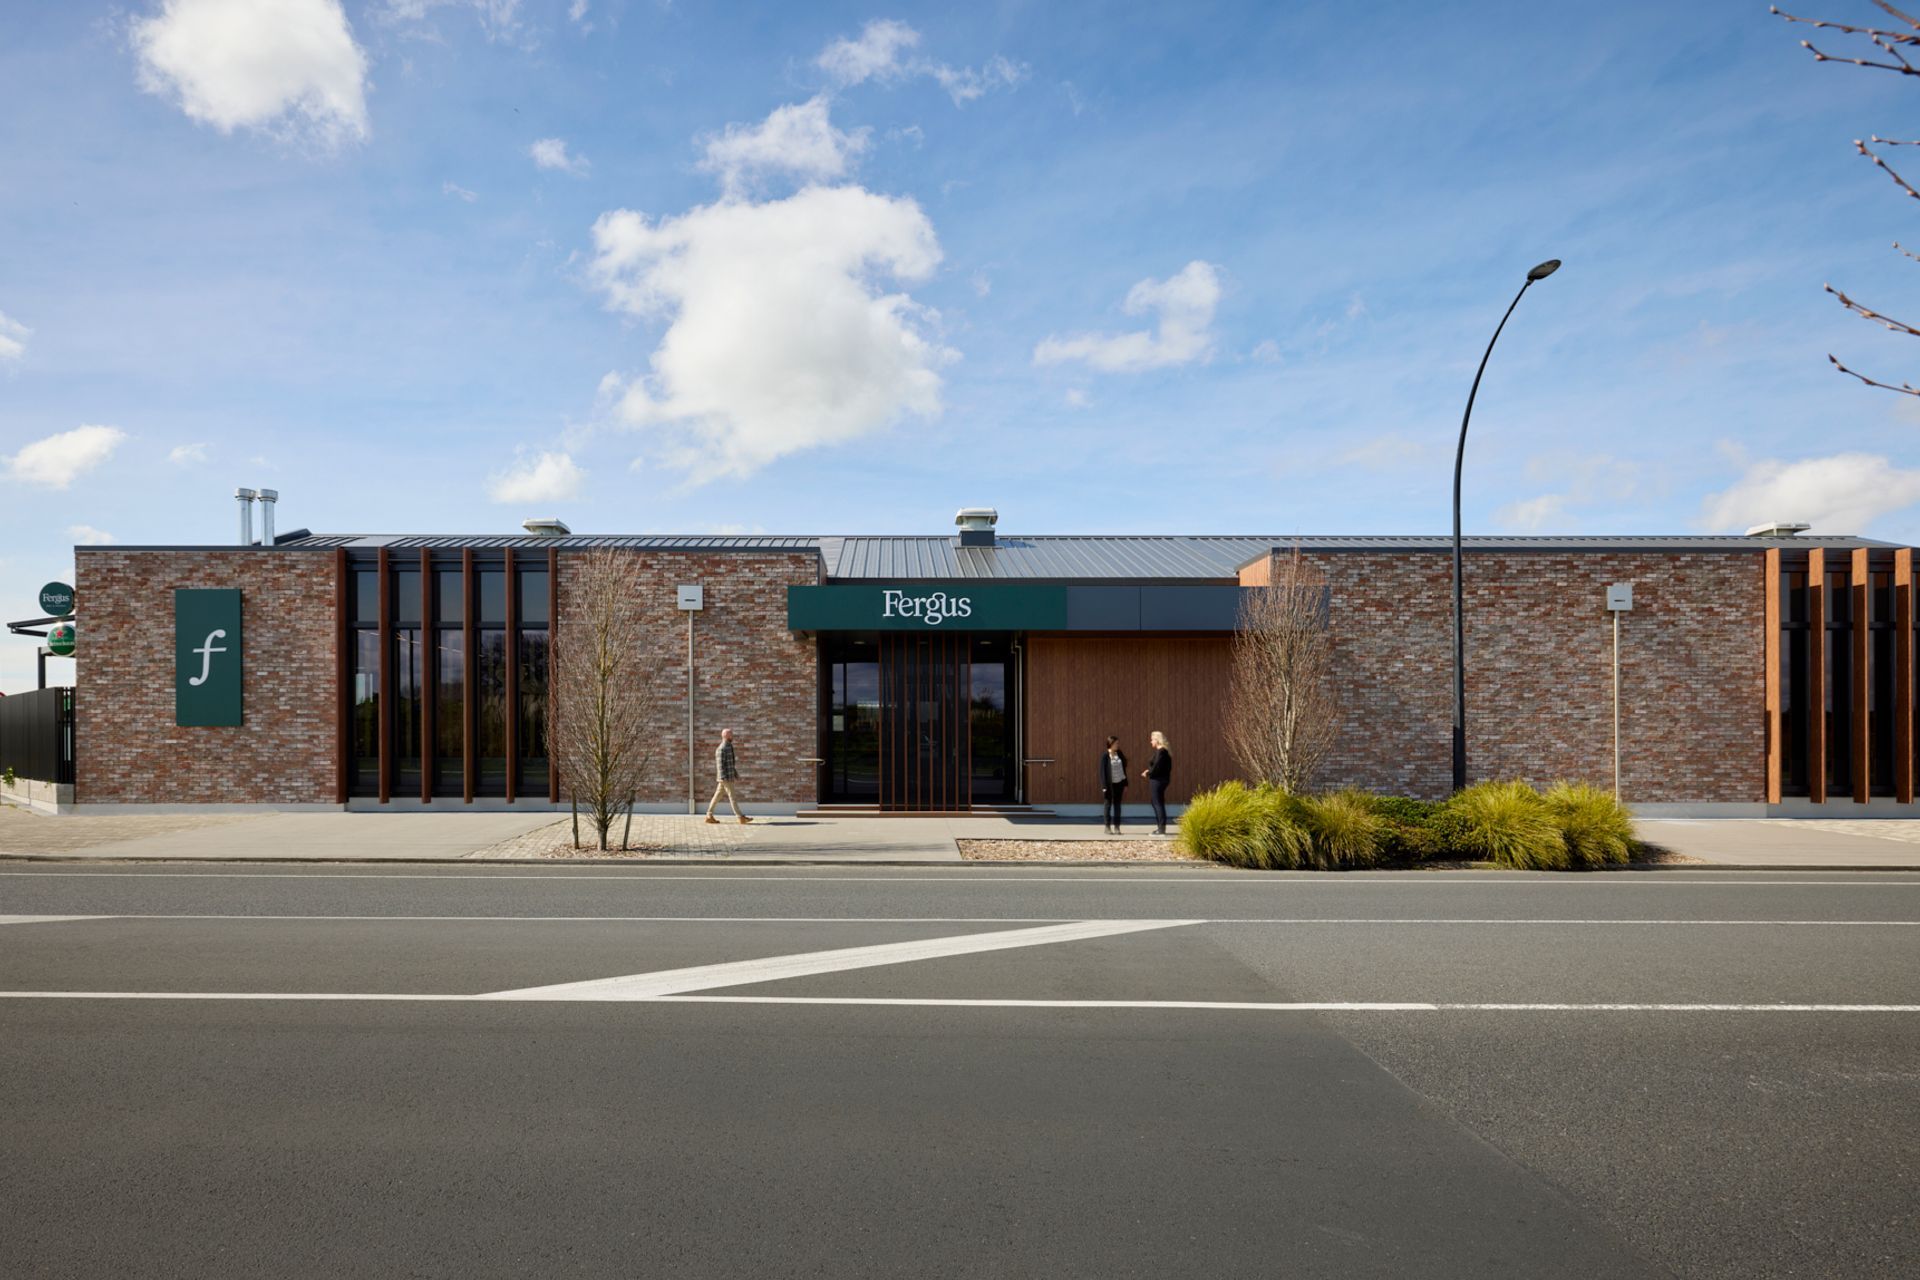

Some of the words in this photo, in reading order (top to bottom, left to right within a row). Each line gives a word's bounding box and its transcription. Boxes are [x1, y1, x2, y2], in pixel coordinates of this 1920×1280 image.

[42, 593, 70, 604] Fergus
[882, 589, 972, 625] Fergus
[189, 629, 227, 686] f
